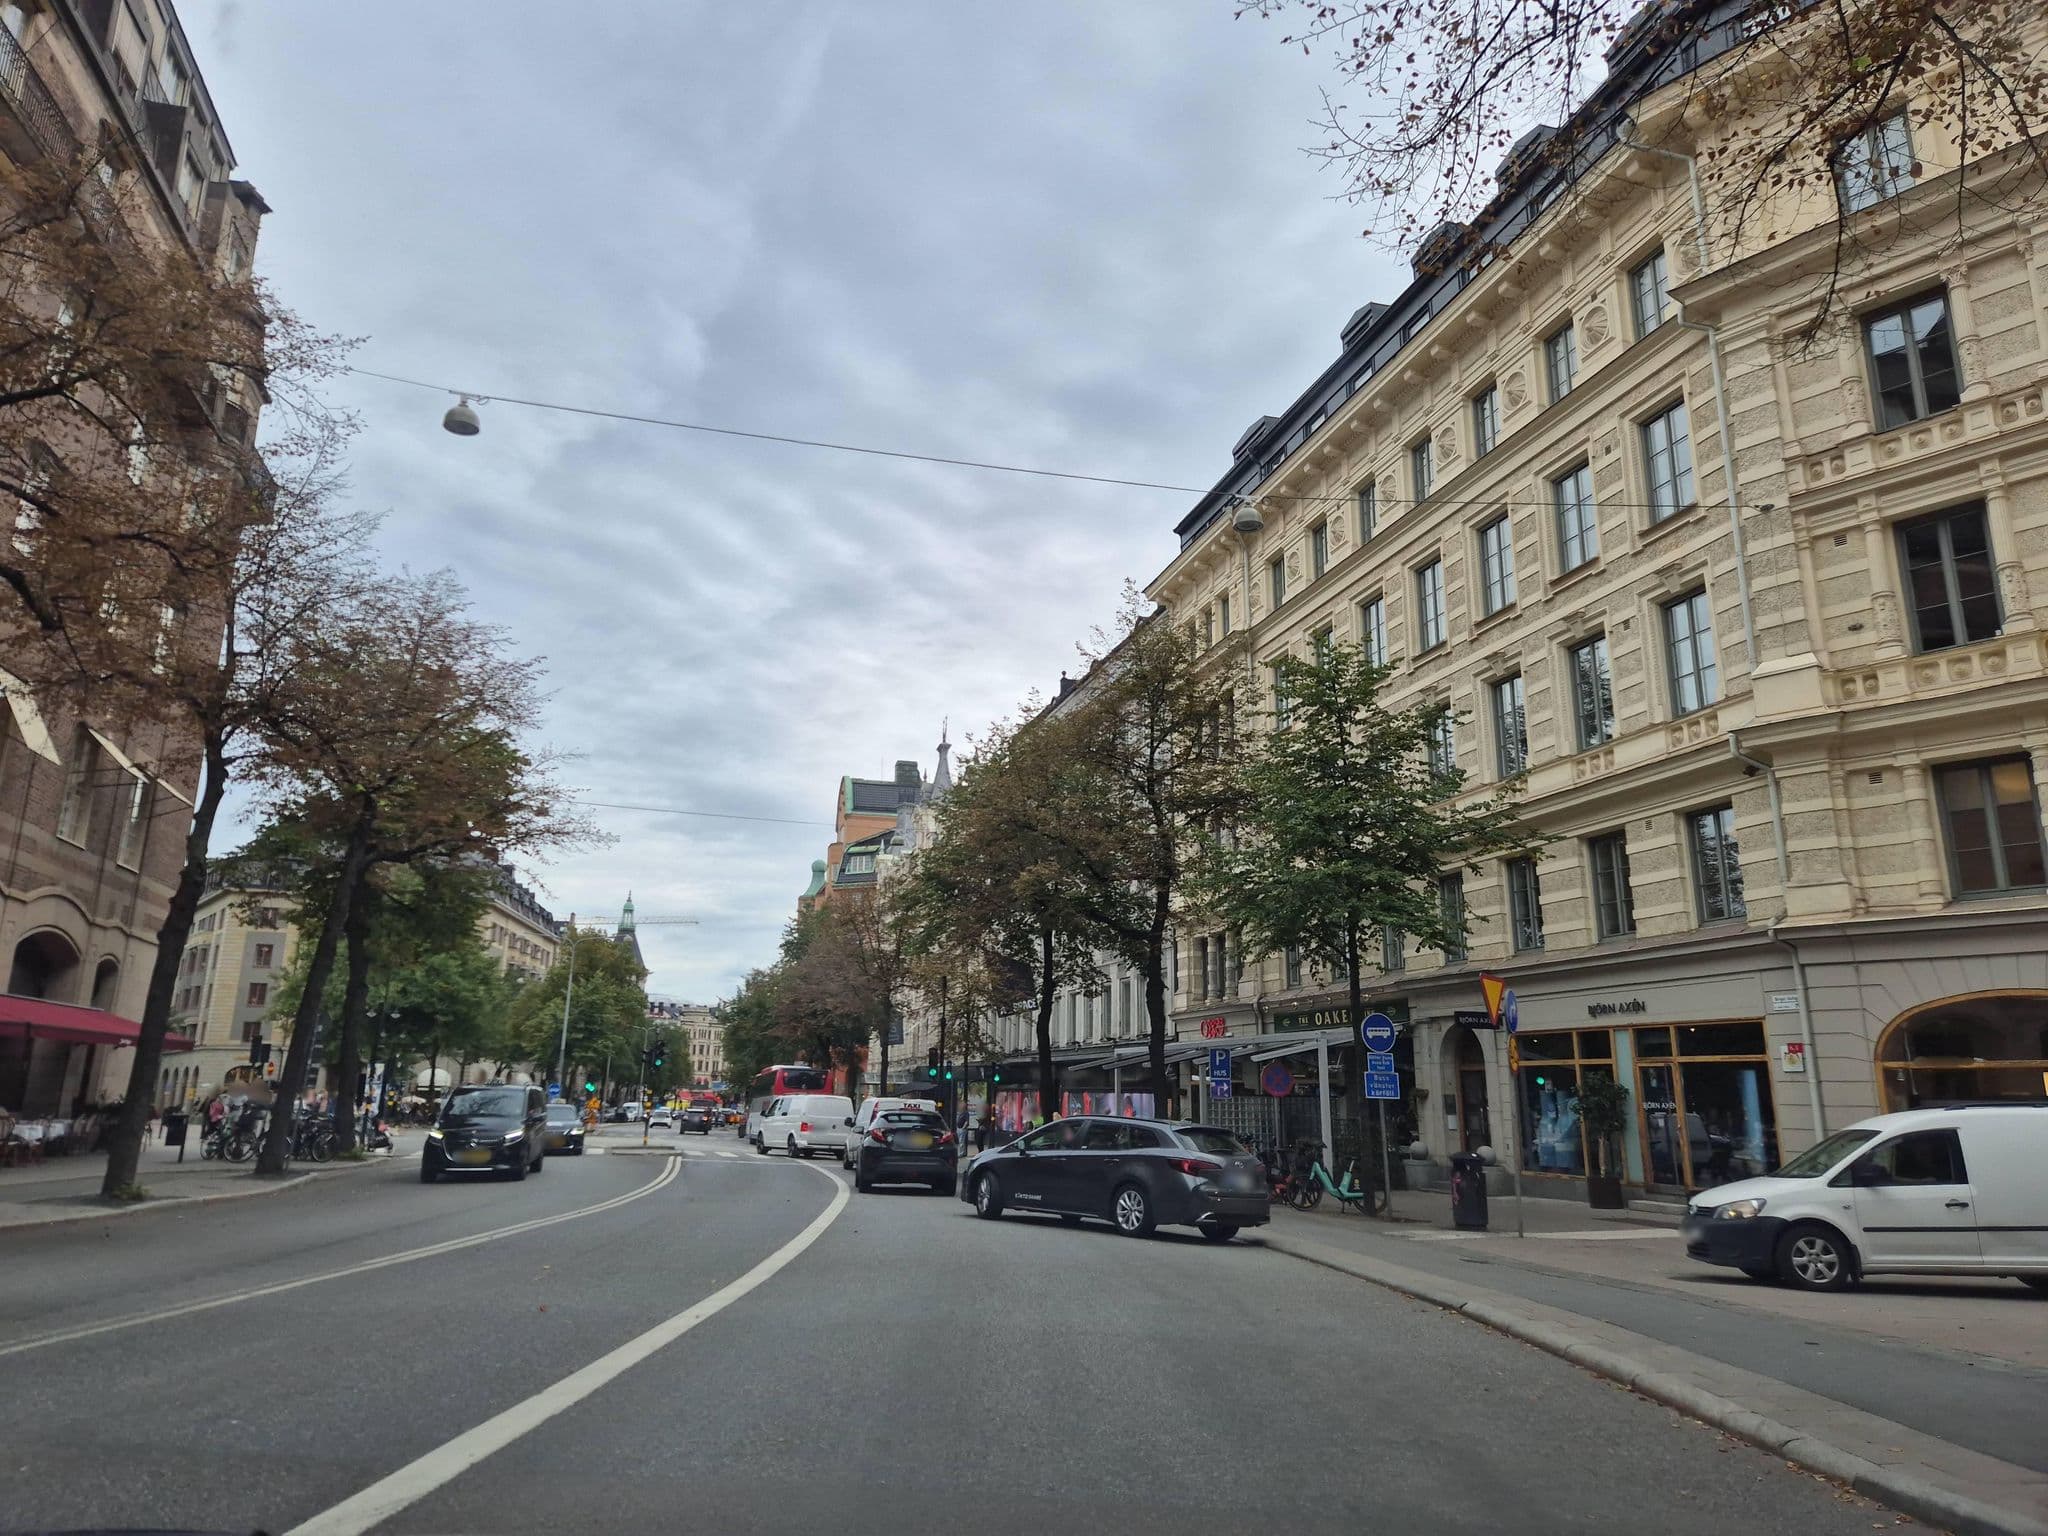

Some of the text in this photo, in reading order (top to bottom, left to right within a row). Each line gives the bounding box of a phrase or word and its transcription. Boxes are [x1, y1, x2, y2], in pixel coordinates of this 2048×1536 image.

[1298, 1015, 1309, 1025] THE
[1315, 1009, 1353, 1025] OAKE
[1588, 1002, 1616, 1018] BJÖRN
[1216, 1050, 1226, 1066] P
[1213, 1069, 1227, 1077] HUS
